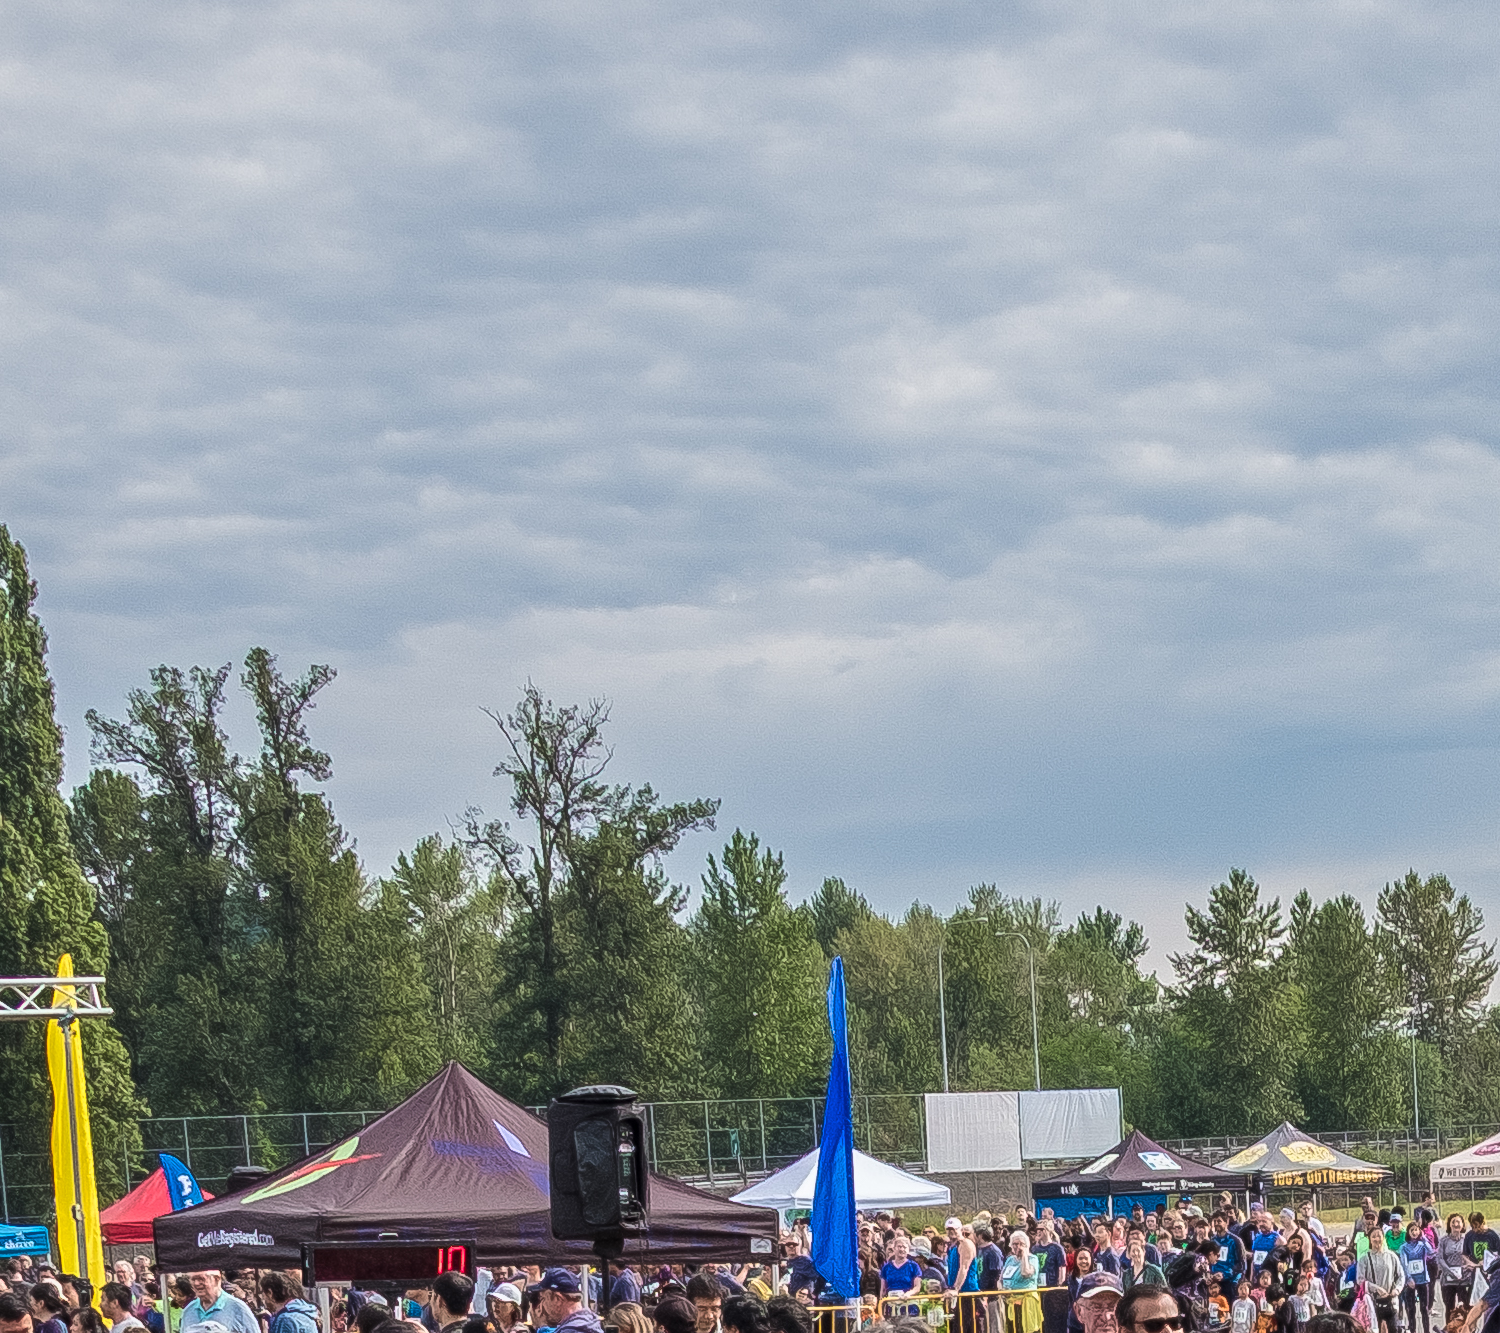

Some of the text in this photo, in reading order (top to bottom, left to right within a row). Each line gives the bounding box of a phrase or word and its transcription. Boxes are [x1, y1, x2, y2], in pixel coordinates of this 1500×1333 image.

[1446, 1165, 1495, 1177] WE LOVE PETS!
[1273, 1171, 1304, 1187] 100%
